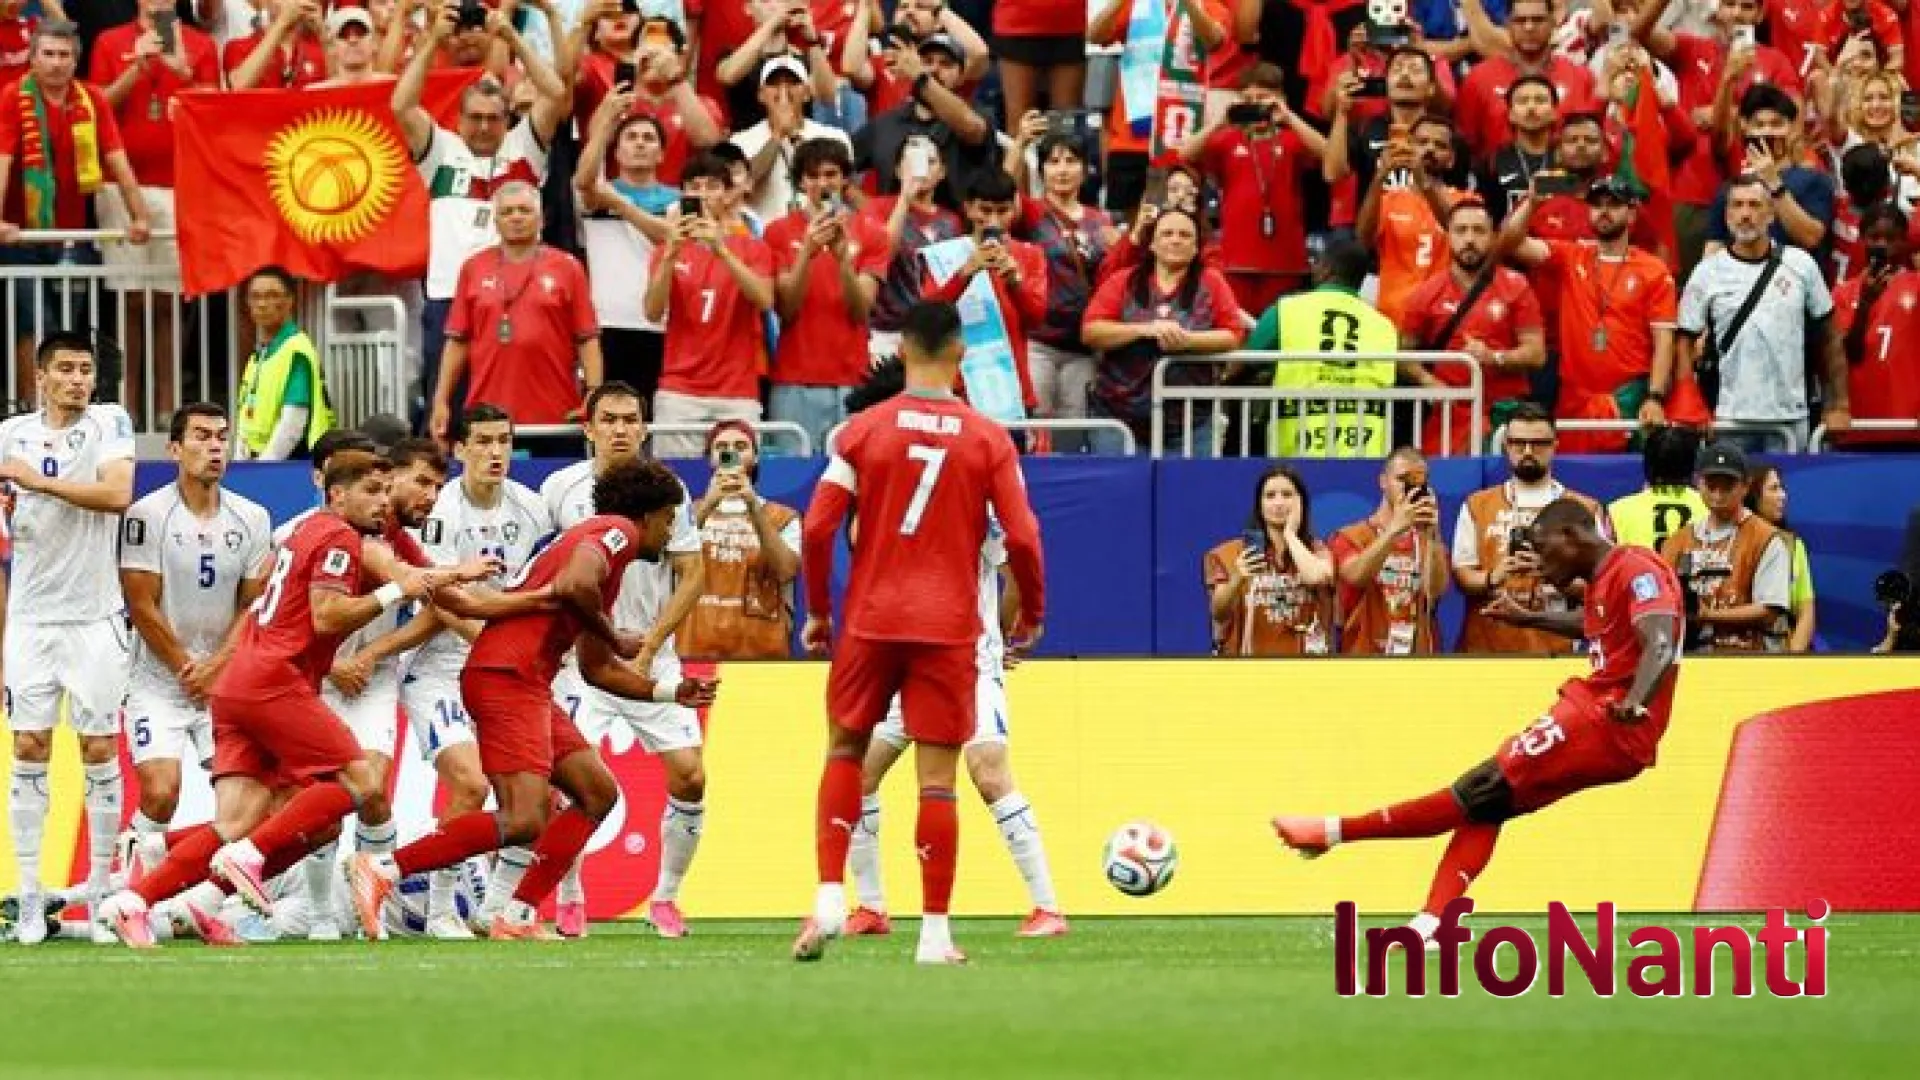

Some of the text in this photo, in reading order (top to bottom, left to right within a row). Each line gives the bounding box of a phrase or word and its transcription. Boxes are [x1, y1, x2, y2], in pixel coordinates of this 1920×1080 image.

[1416, 233, 1433, 267] 2
[701, 289, 716, 323] 7
[1877, 325, 1892, 360] 7
[900, 444, 948, 535] 7
[199, 553, 216, 588] 5
[565, 694, 582, 721] 7
[134, 716, 152, 748] 5
